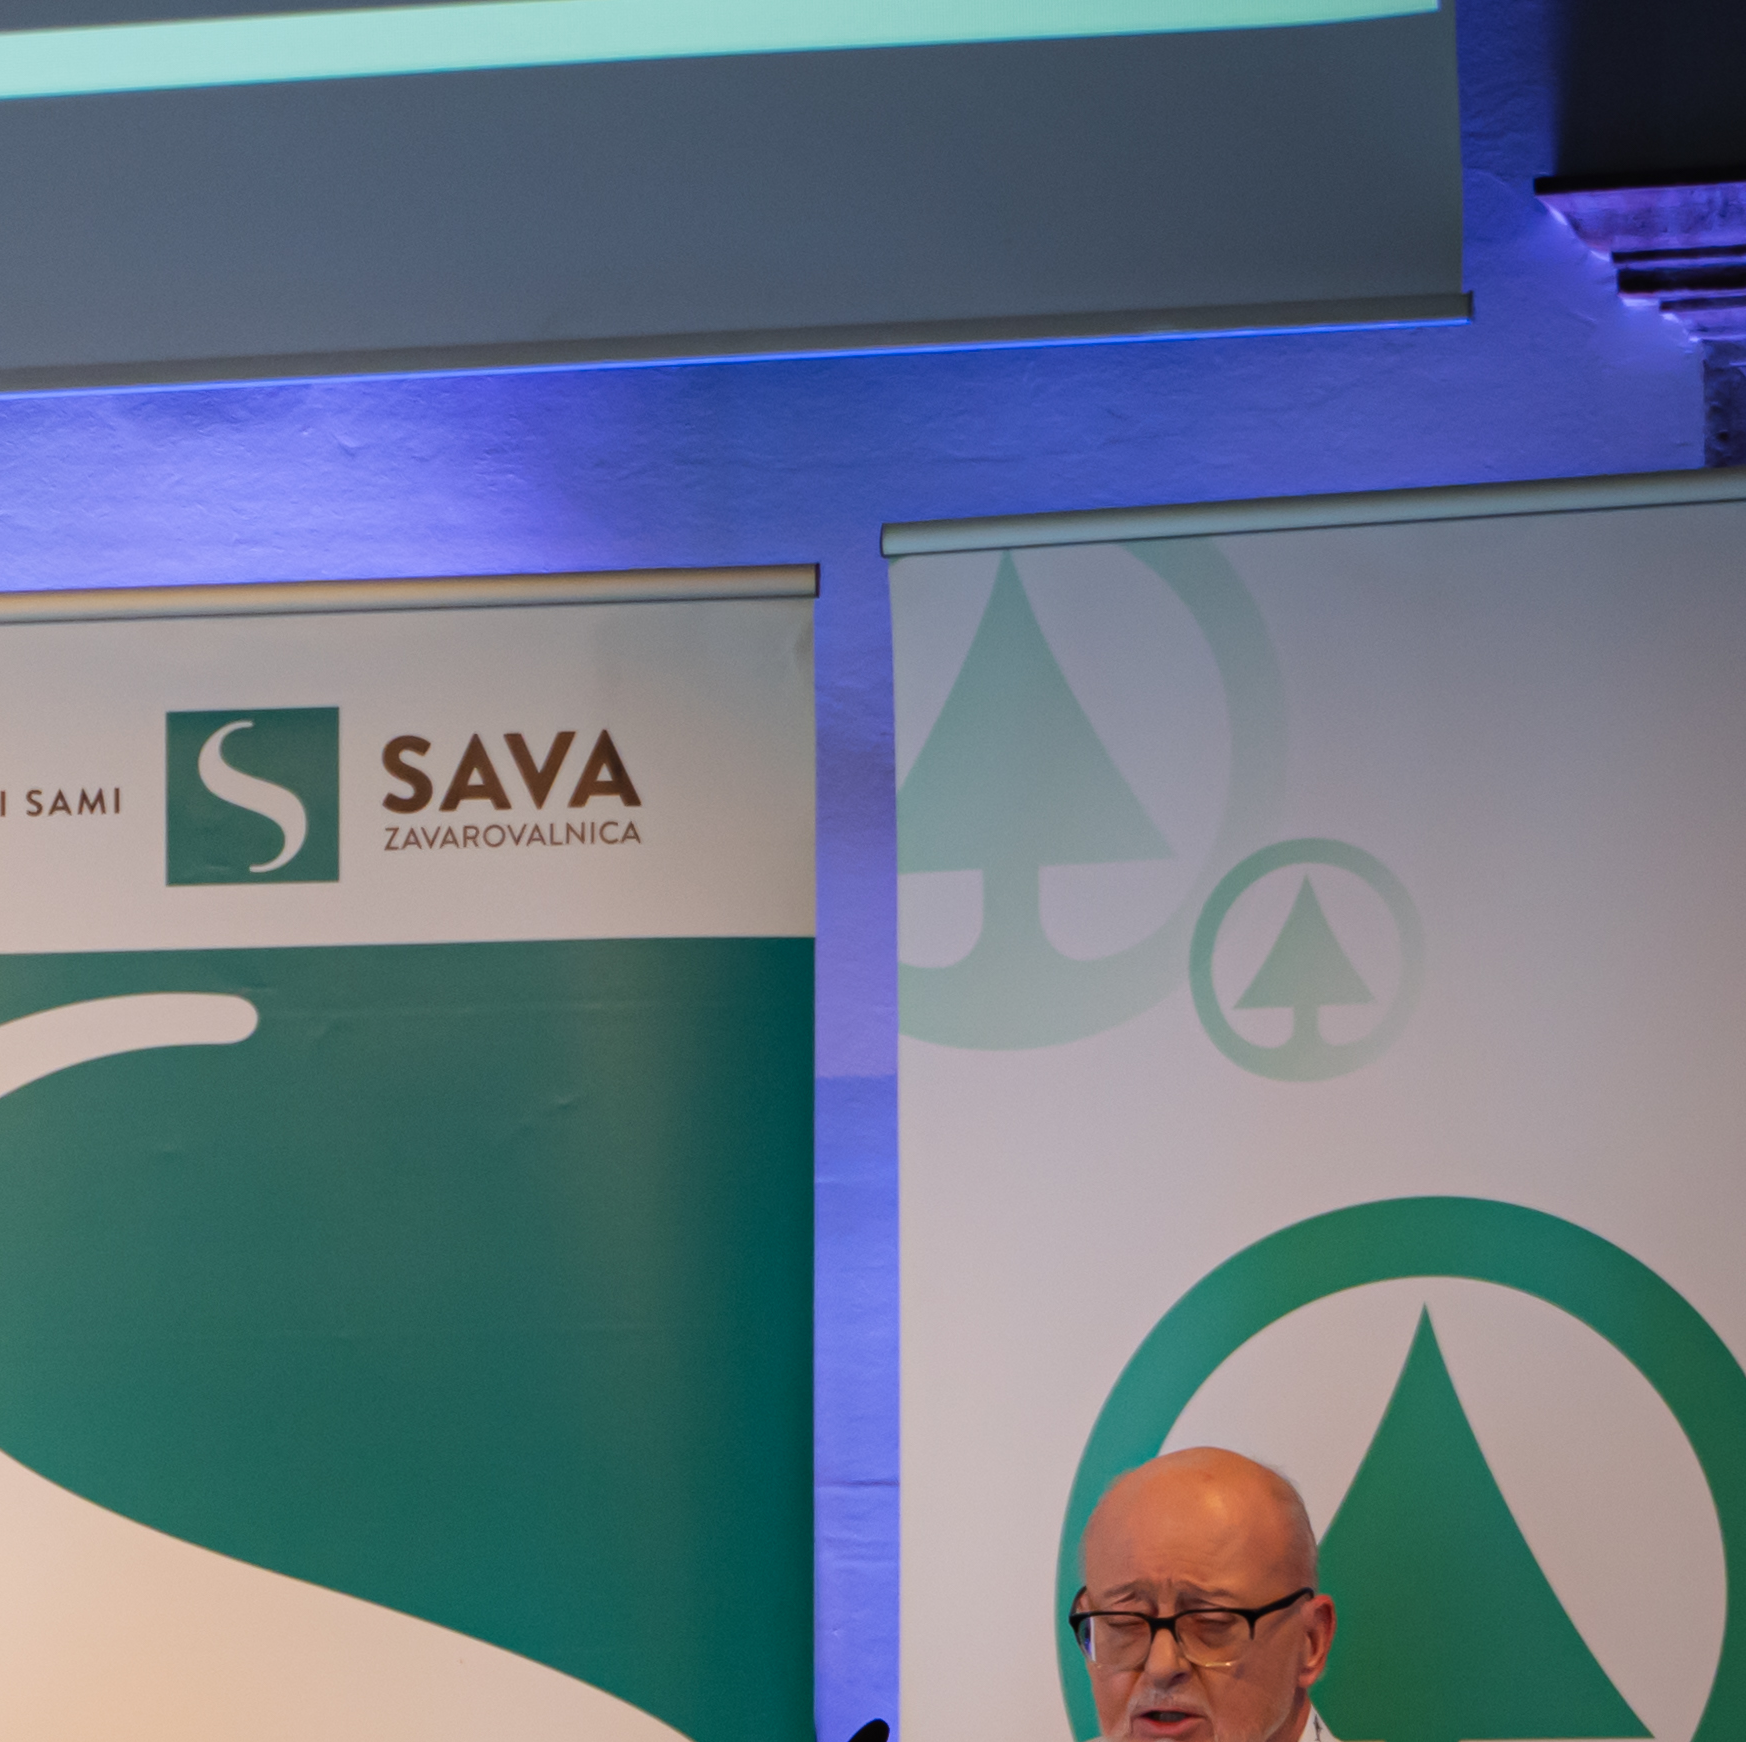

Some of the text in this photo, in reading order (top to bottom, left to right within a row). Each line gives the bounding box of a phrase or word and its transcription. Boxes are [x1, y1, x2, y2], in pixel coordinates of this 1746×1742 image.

[382, 729, 642, 814] SAVA
[26, 787, 122, 817] SAMI
[385, 821, 642, 851] ZAVAROVALNICA
